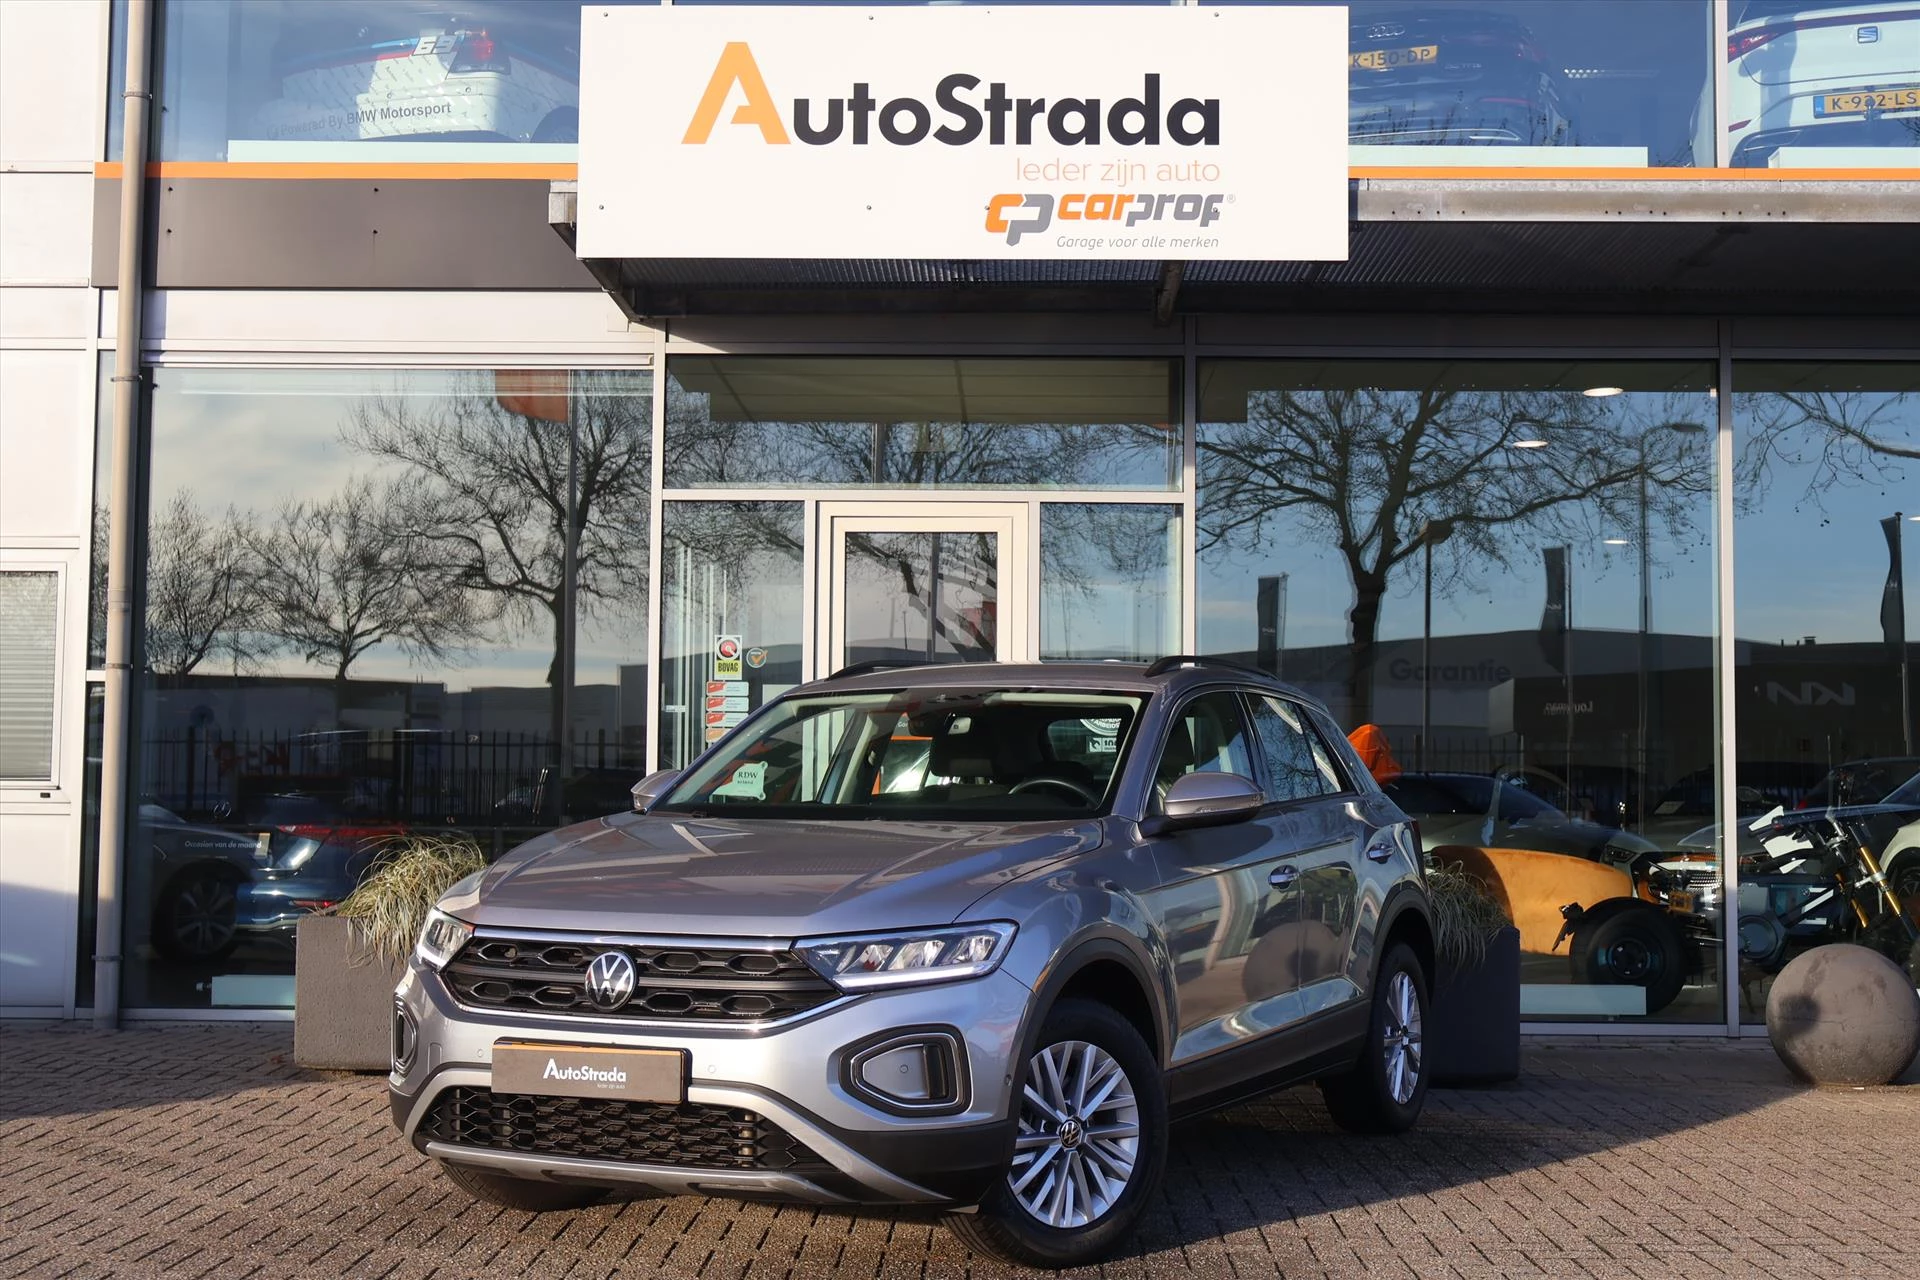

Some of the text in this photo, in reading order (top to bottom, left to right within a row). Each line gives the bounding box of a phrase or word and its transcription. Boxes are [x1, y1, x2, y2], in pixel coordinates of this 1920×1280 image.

[412, 35, 458, 55] 69
[1352, 48, 1431, 68] K-150-DP
[681, 42, 1220, 146] AutoStrada
[329, 114, 344, 130] By
[346, 109, 377, 125] BMW
[380, 102, 452, 121] Motorsport
[1016, 157, 1220, 187] Ieder zijn auto
[1056, 235, 1219, 250] Garage voor alle merken
[717, 662, 739, 673] BOVAG
[1389, 658, 1512, 683] Garantie
[738, 771, 758, 779] RDW
[543, 1058, 627, 1082] AutoStrada
